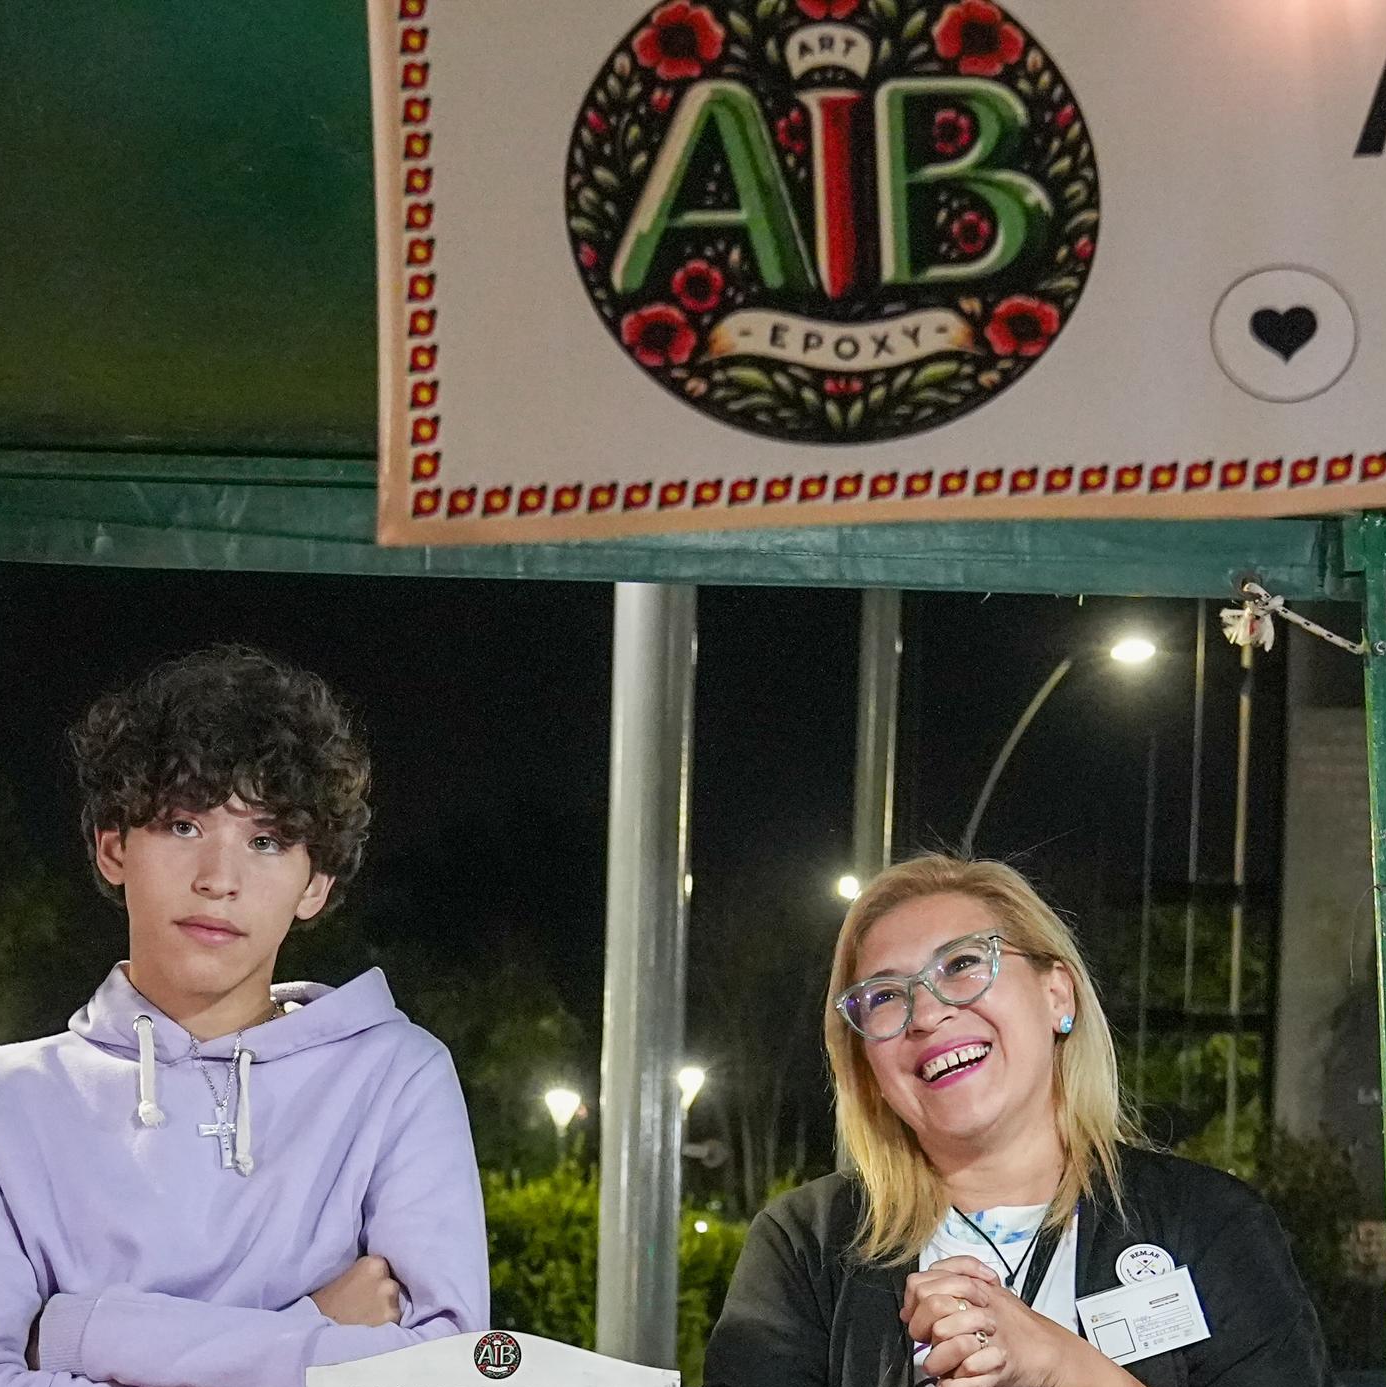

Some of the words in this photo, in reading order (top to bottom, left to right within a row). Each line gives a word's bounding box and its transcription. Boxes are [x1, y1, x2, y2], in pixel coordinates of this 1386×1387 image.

[613, 76, 1054, 300] AIB
[770, 322, 920, 361] EPOXY
[478, 1344, 516, 1367] AIB
